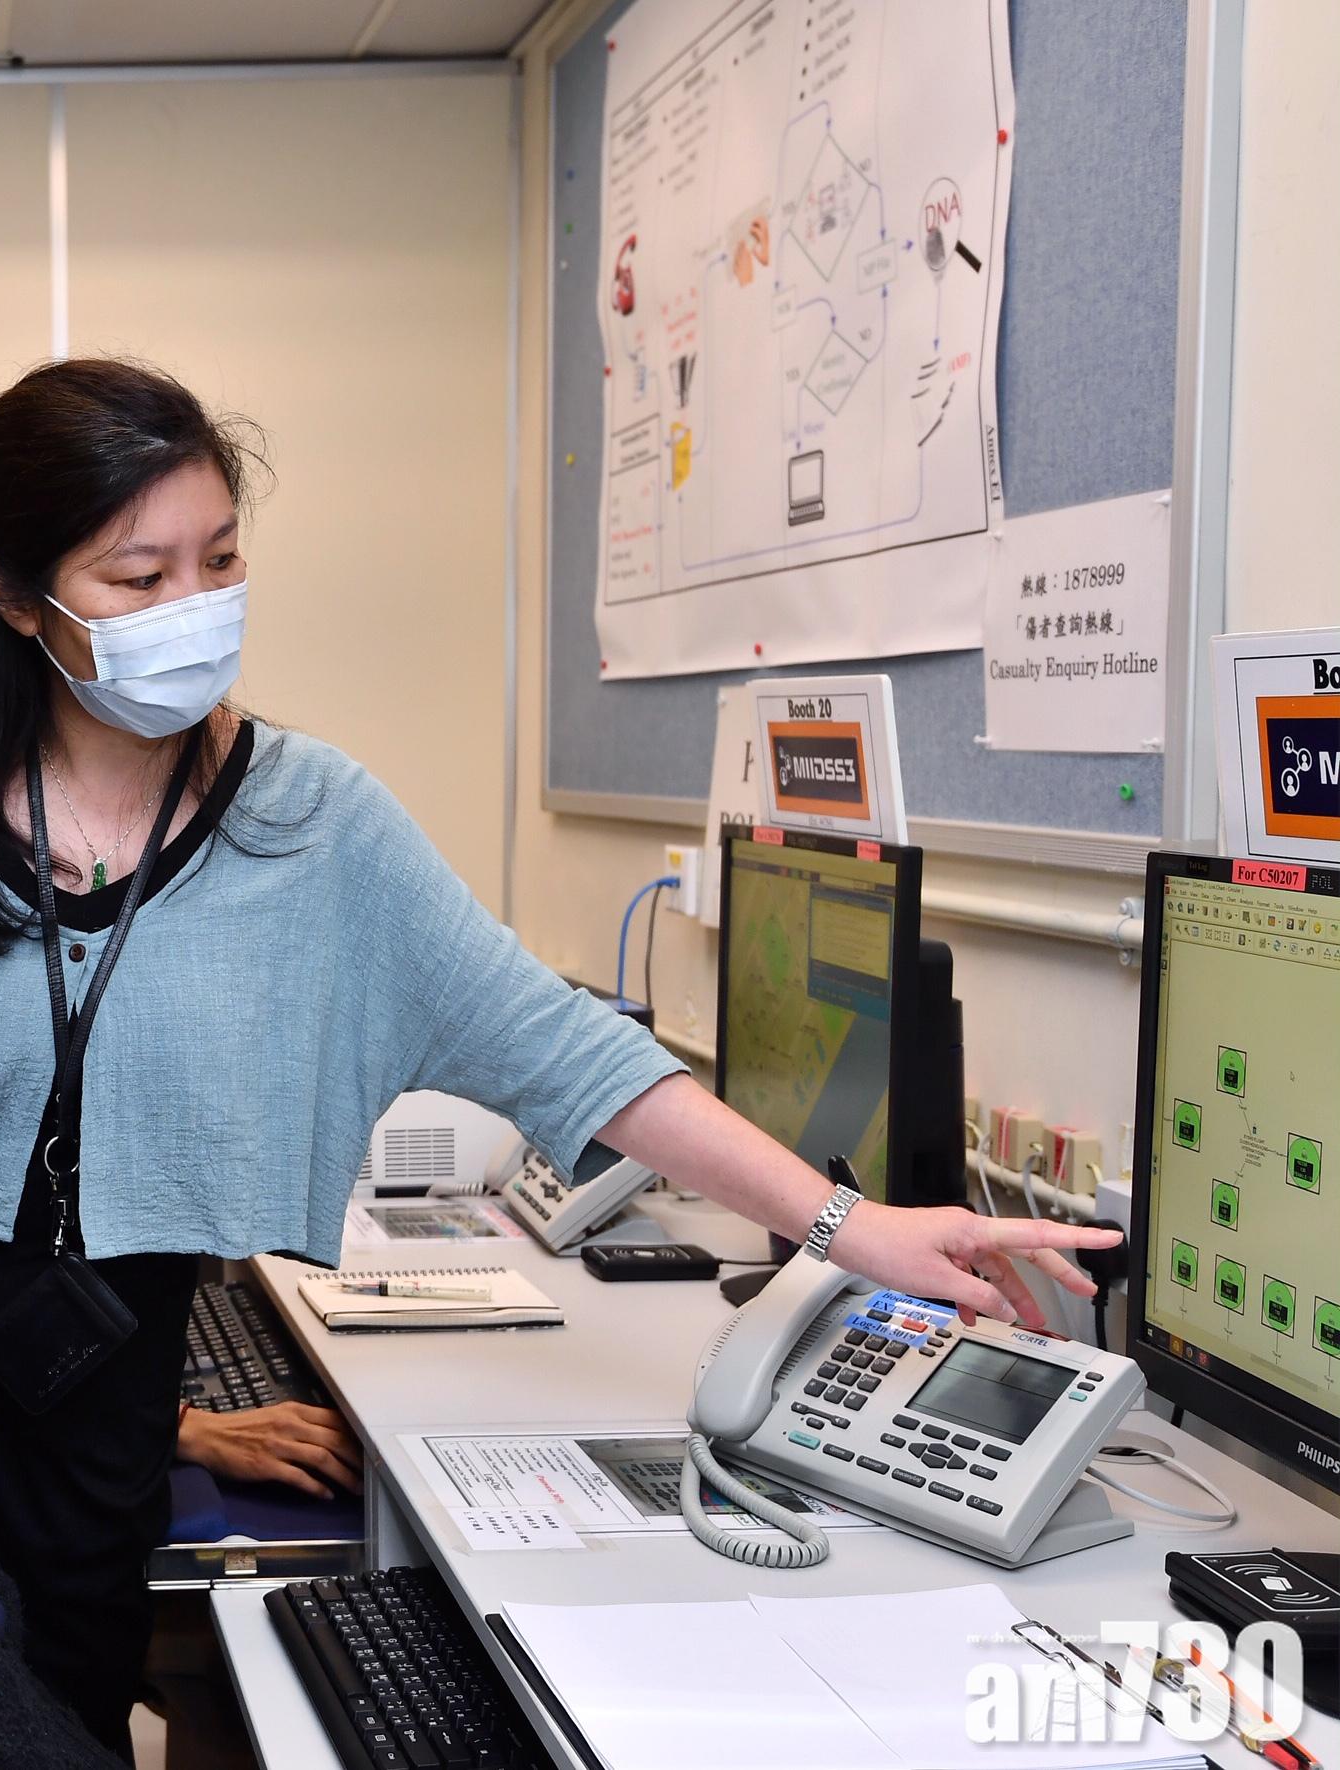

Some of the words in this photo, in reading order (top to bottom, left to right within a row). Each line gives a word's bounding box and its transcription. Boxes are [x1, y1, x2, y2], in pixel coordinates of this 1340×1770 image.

[925, 191, 961, 232] DNA
[989, 657, 1042, 682] Casualty
[1046, 655, 1099, 681] Enquiry
[1102, 651, 1158, 675] Hotline
[787, 698, 816, 719] Booth
[818, 697, 832, 718] 20
[1238, 865, 1257, 881] For
[1258, 867, 1300, 886] C50207
[882, 1291, 913, 1305] Booth
[852, 1316, 888, 1336] Log-In
[889, 1328, 917, 1340] 3019
[1011, 1332, 1048, 1347] NORTEL
[1297, 1441, 1340, 1474] PHILIPS
